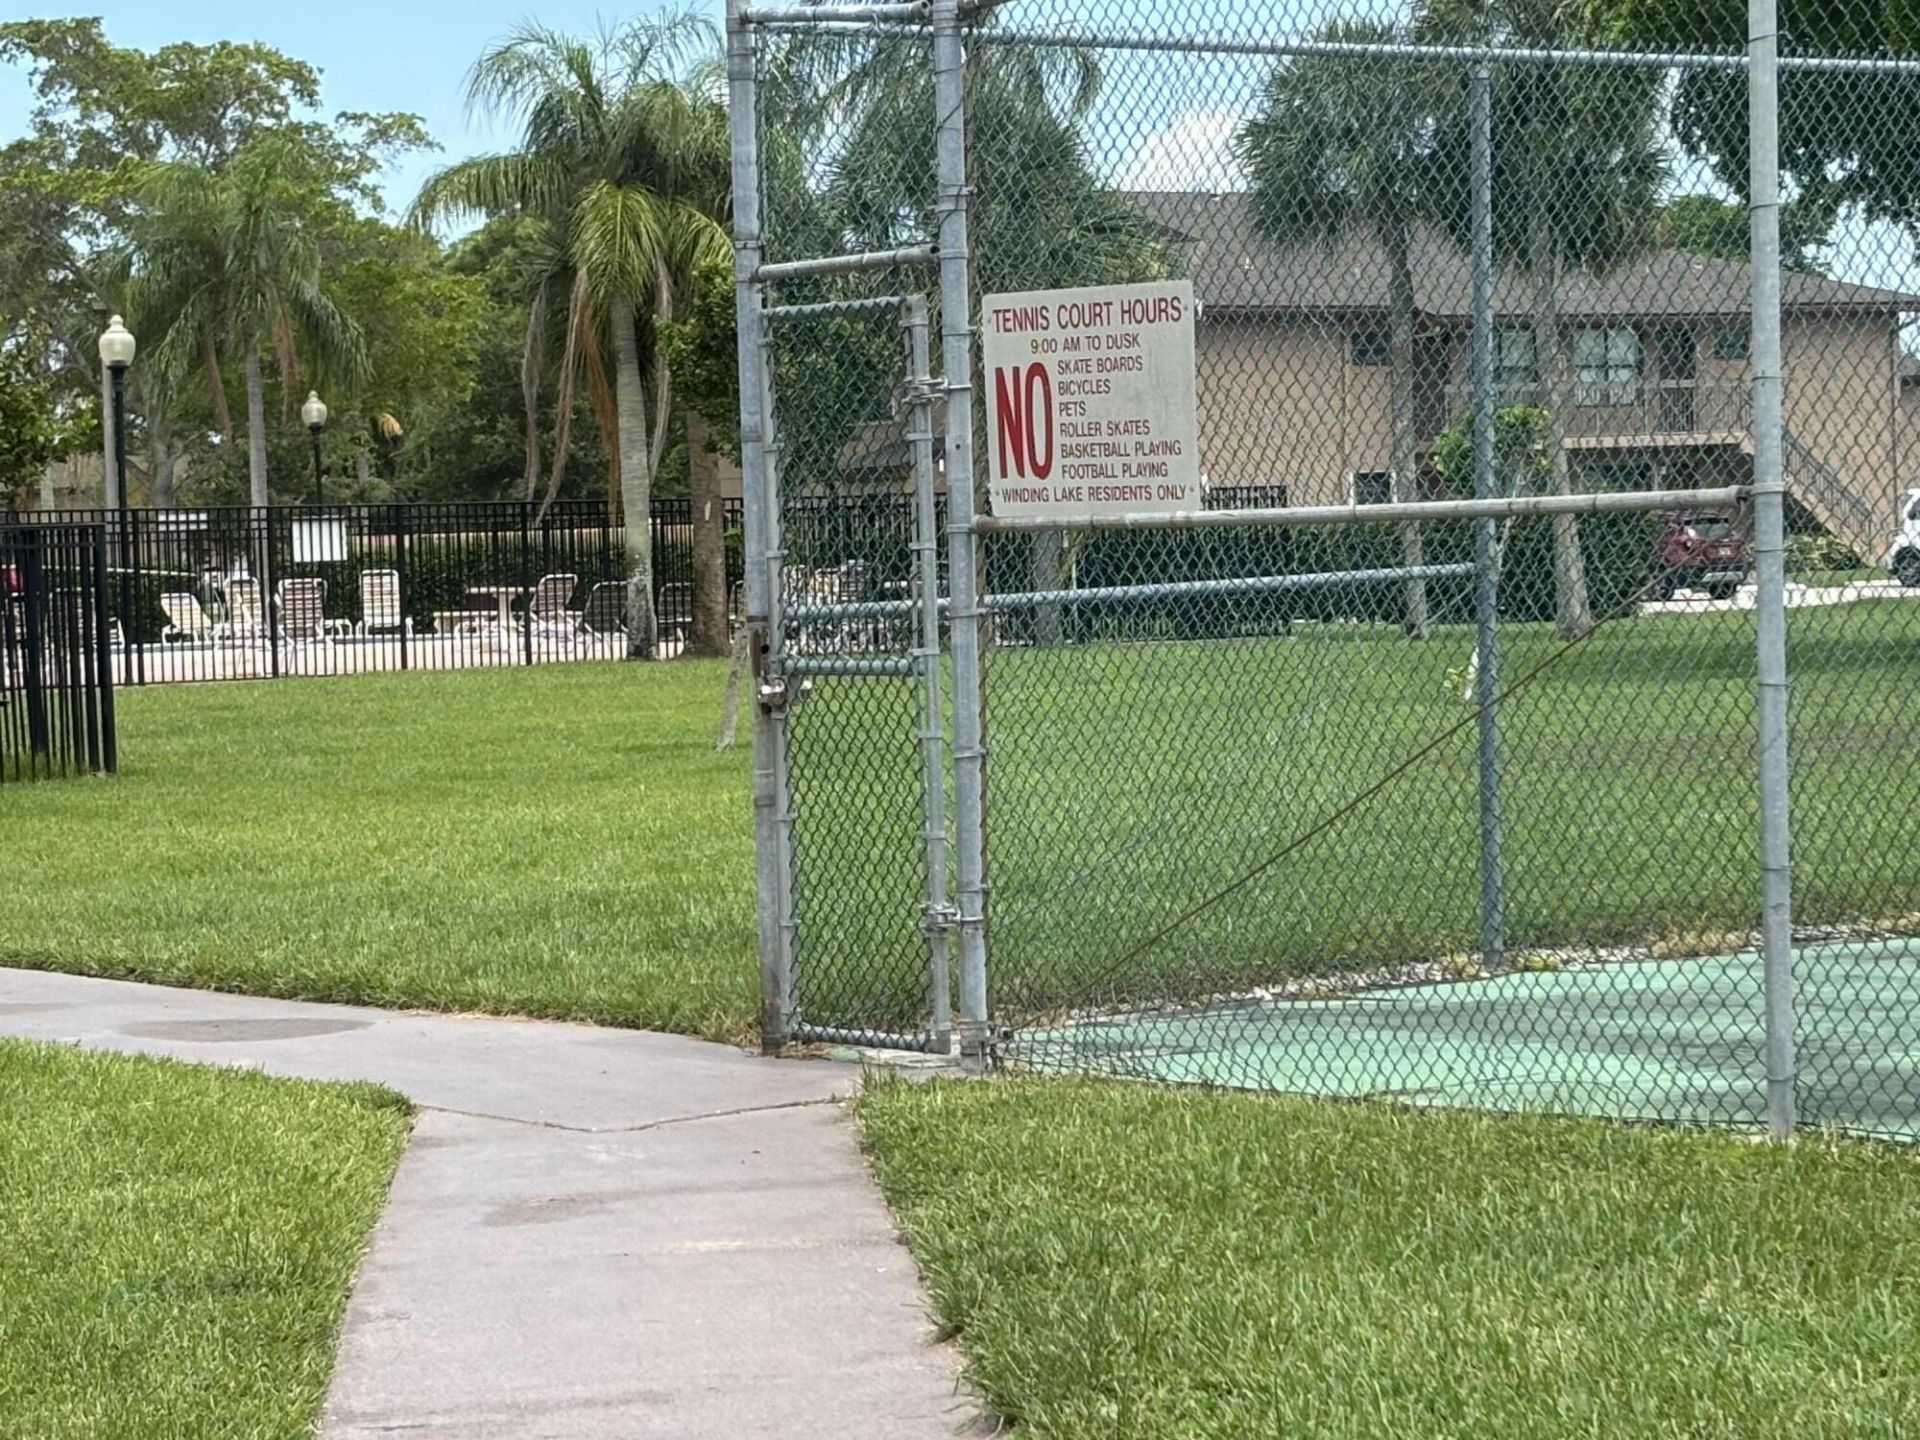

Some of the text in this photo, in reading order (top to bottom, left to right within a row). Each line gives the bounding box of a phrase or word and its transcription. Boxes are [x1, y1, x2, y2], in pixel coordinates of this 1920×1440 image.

[993, 296, 1182, 333] TENNIS COURT HOURS
[1062, 336, 1081, 352] AM
[1085, 335, 1101, 350] TO
[1106, 332, 1141, 350] DUSK
[1057, 355, 1143, 375] SKATE BOARDS
[1058, 378, 1111, 396] BICYCLES
[1059, 401, 1086, 417] PETS
[994, 361, 1053, 480] NO
[1060, 419, 1150, 437] ROLLER SKATES
[1061, 439, 1182, 459] BASKETBALL PLAYING
[1062, 462, 1168, 479] FOOTBALL PLAYING
[1002, 484, 1186, 503] WINDING LAKE RESIDENTS ONLY
